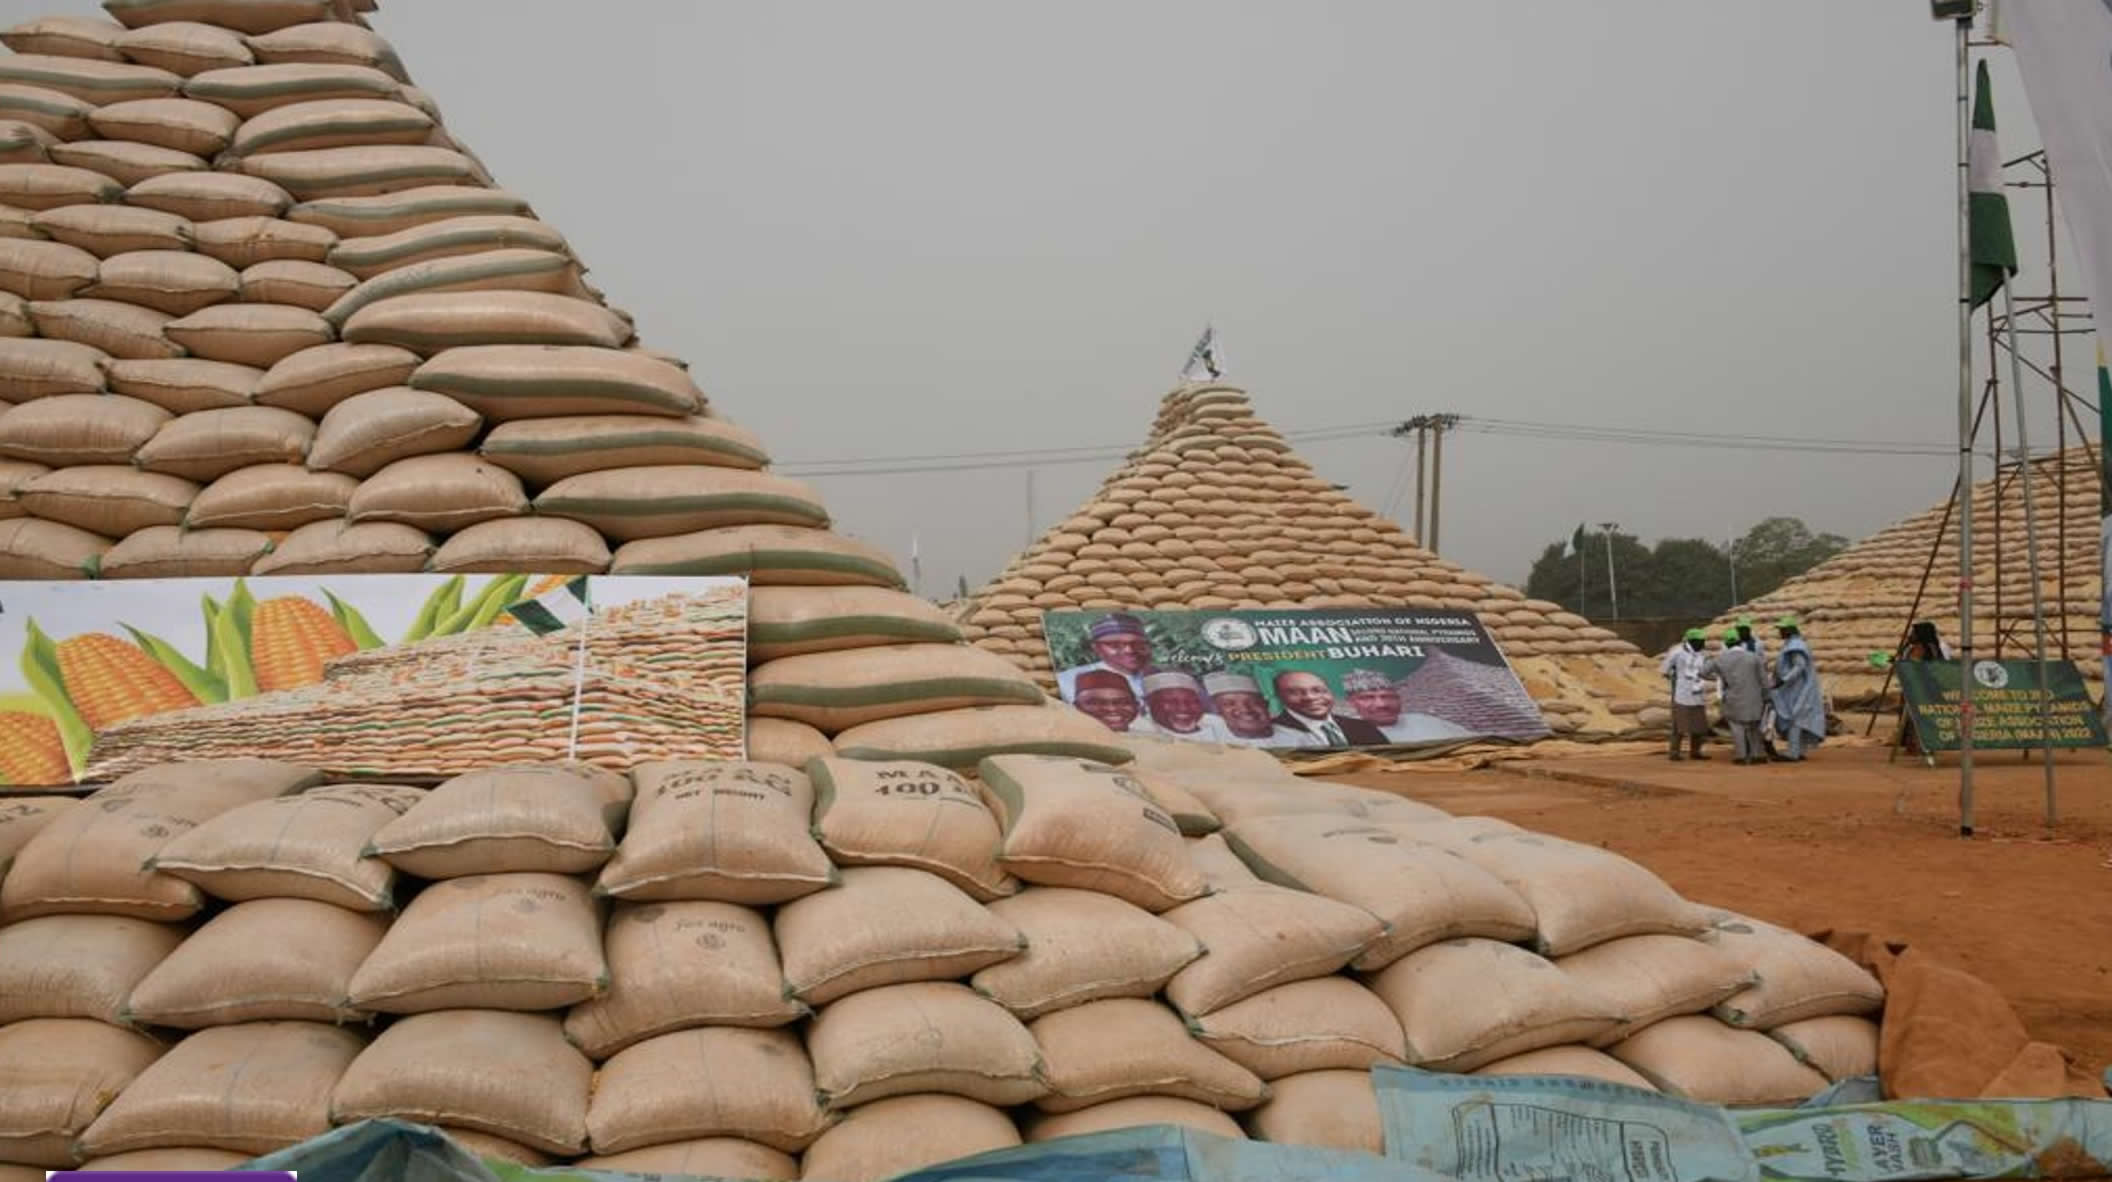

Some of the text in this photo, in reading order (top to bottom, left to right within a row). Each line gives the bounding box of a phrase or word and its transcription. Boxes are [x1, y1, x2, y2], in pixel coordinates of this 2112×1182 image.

[1257, 626, 1353, 646] MAAN
[1228, 650, 1327, 661] PRESIDENT
[1327, 643, 1426, 659] BUHARI
[1942, 689, 2007, 702] WECOME
[1918, 703, 1981, 716] NATIONL
[2023, 701, 2091, 714] PYAMIDS
[1999, 715, 2084, 728] ASSOCATION
[1957, 728, 2012, 742] GERIA
[1867, 1124, 1889, 1170] AYER
